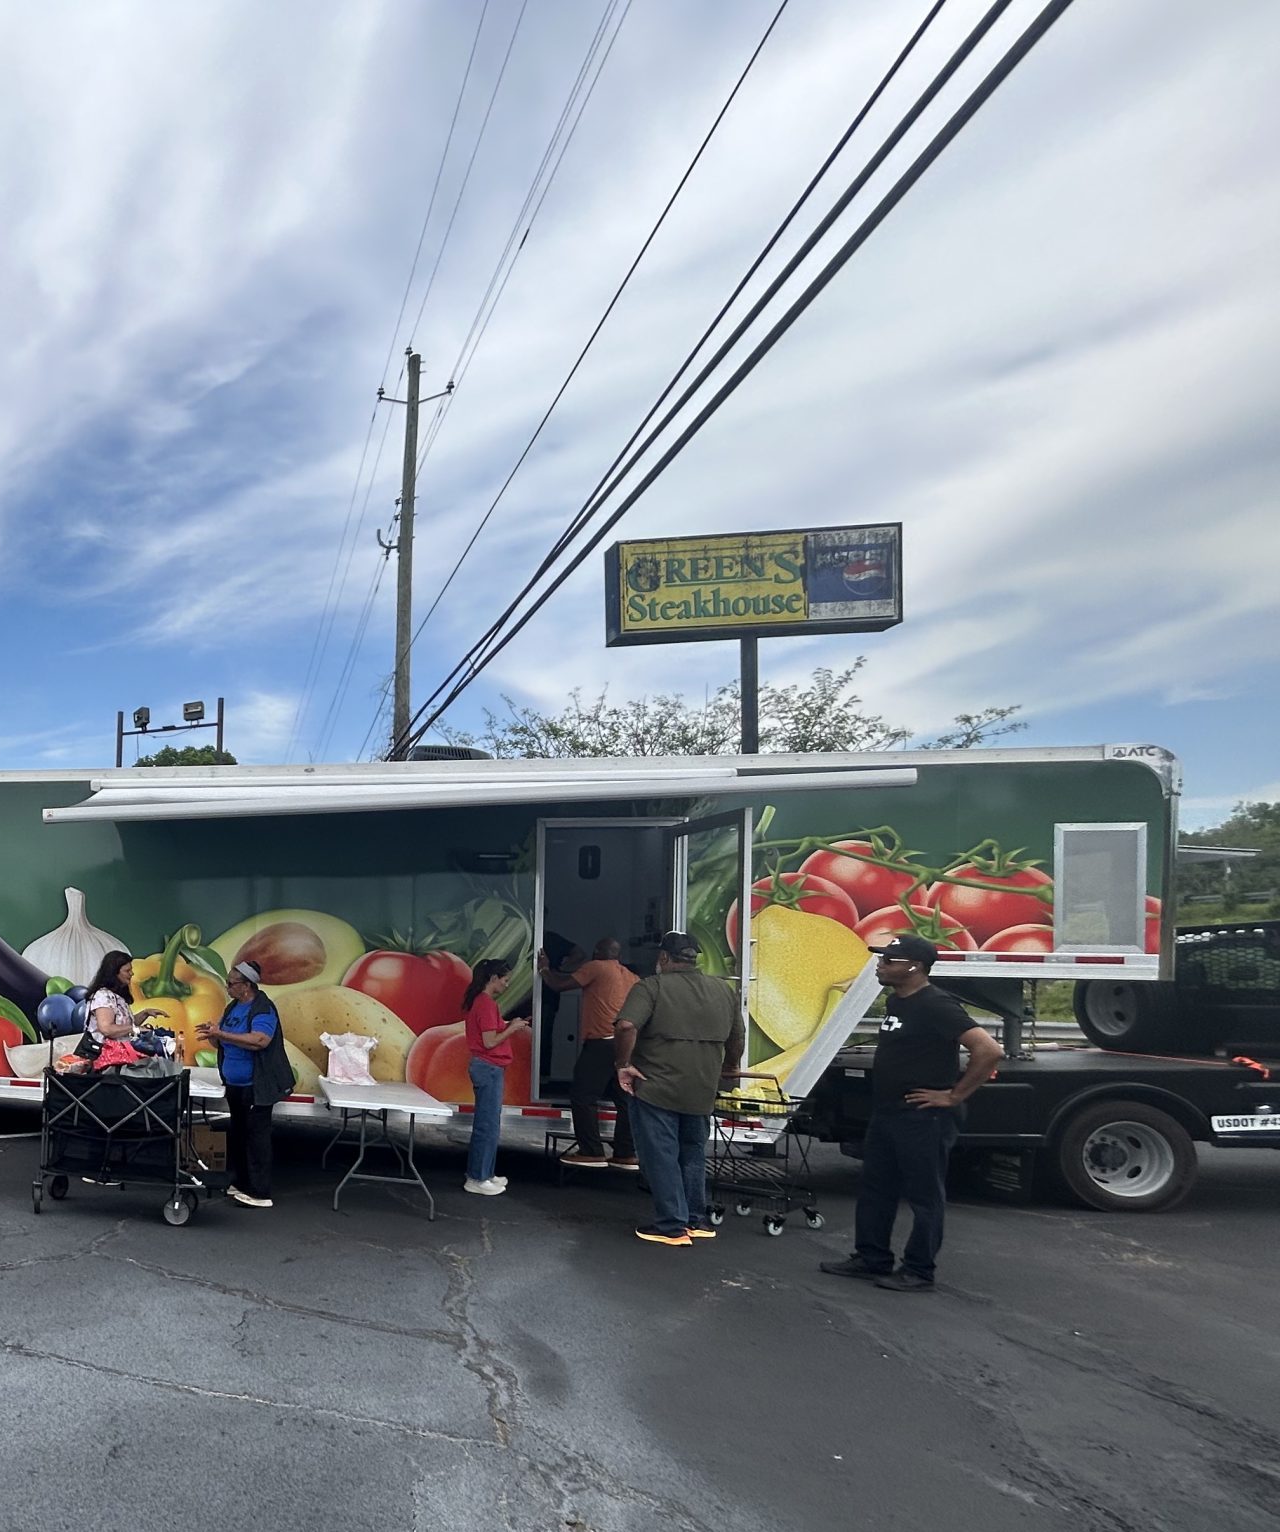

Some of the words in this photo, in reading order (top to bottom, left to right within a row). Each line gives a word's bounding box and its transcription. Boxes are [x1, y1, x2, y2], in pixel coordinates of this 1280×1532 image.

[627, 550, 802, 593] GREEN'S
[628, 587, 802, 622] Steakhouse
[1127, 746, 1157, 756] ATC
[1217, 1117, 1255, 1128] USDOT
